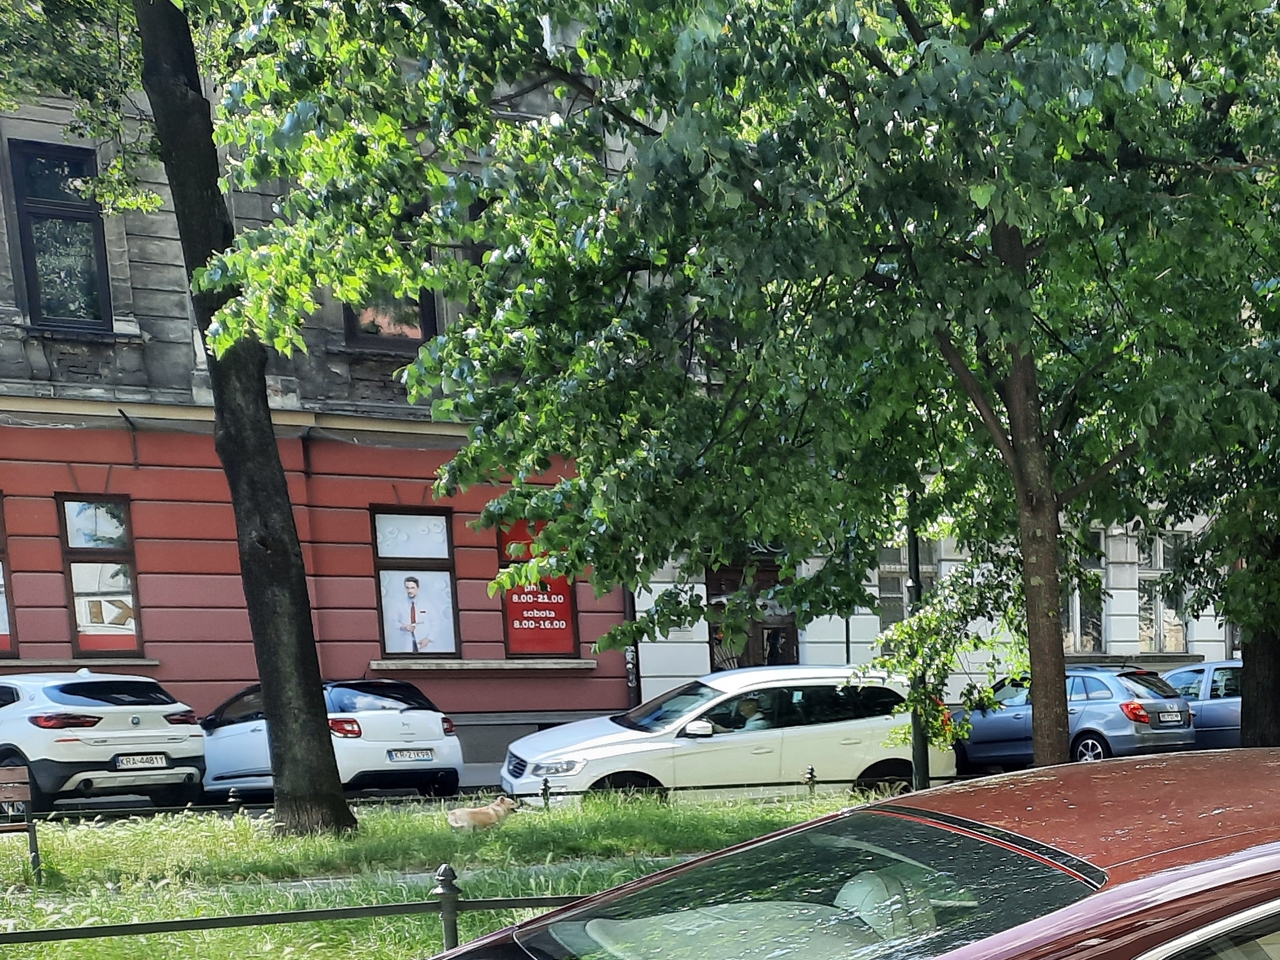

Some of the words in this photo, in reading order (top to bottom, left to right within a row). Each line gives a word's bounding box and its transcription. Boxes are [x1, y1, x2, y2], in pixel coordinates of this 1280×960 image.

[512, 594, 564, 604] 8.00-21.00
[523, 609, 556, 618] sobota
[513, 620, 567, 629] 8.00-16.00
